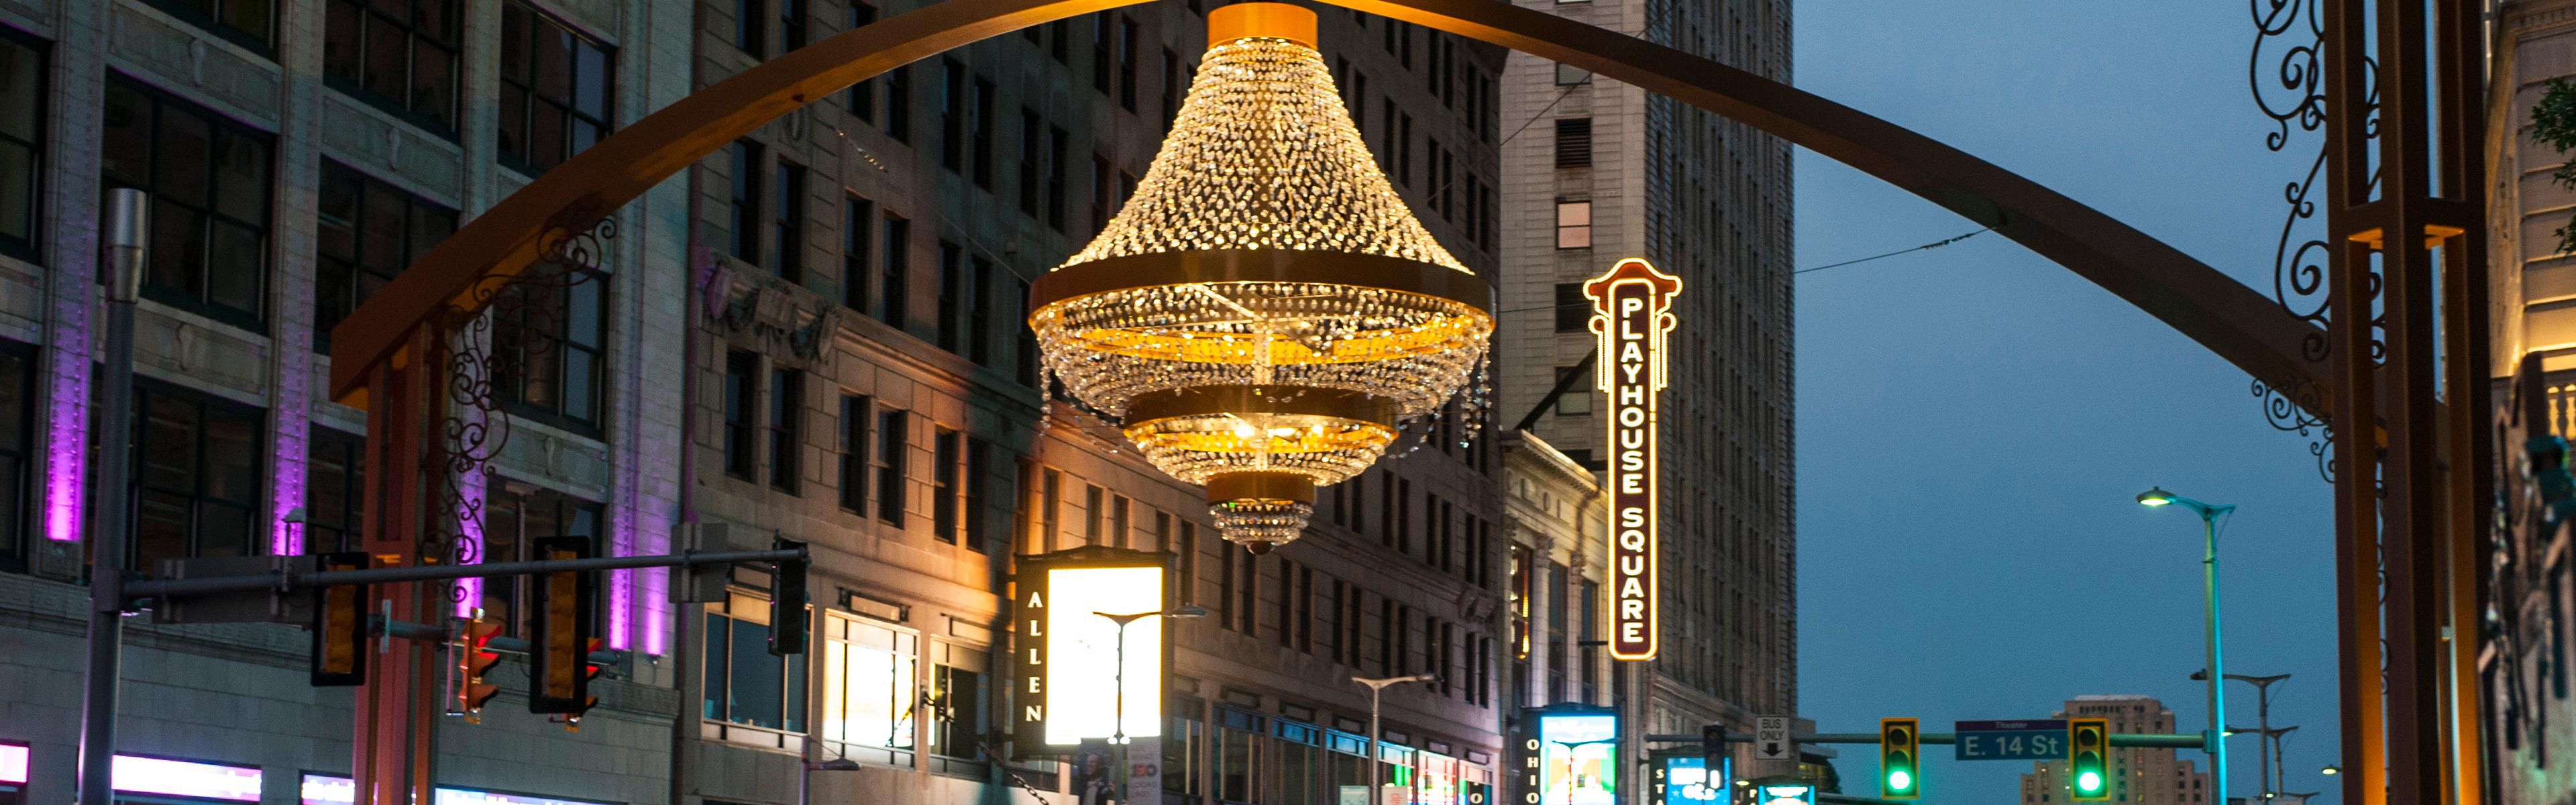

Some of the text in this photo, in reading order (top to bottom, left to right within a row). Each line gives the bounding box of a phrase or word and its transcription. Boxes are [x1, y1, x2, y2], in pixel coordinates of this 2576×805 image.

[1620, 297, 1644, 643] PLAYHOUSE SQUARE
[1026, 592, 1043, 722] ALLEN
[1760, 731, 1784, 741] ONLY
[1762, 718, 1782, 729] BUS
[1966, 735, 2058, 755] E. 14 St
[1526, 739, 1540, 804] OHIO
